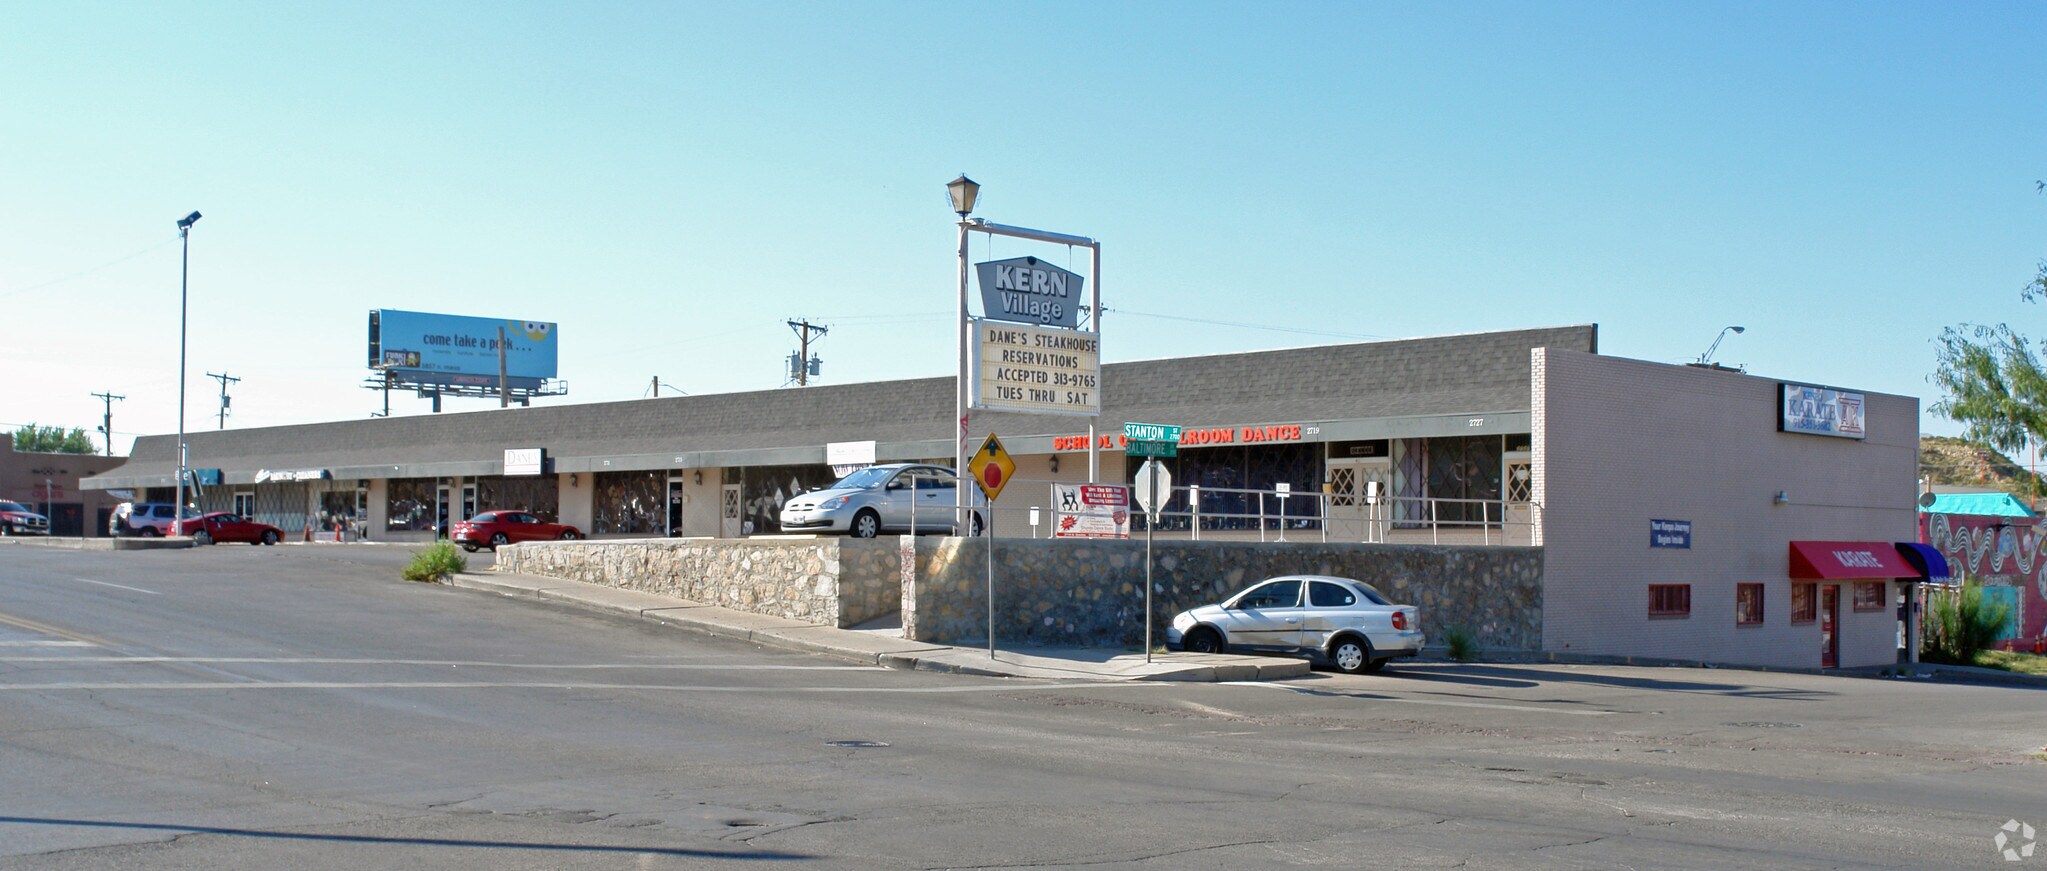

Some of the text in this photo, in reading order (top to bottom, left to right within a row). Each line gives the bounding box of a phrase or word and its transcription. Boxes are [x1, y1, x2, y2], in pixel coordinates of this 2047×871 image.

[996, 264, 1068, 297] KERN
[1000, 291, 1063, 324] Village
[423, 334, 451, 346] come
[454, 333, 477, 348] take
[480, 338, 486, 348] a
[990, 329, 1097, 353] DANE'S STEAKHOUSE
[1003, 349, 1078, 369] RESERVATIONS
[997, 367, 1096, 388] ACCEPTED 313-9765
[997, 386, 1088, 405] TUES THRU SAT
[1788, 399, 1836, 420] KARATE
[1125, 424, 1164, 439] STANTON
[1306, 427, 1319, 435] 2719
[1469, 418, 1483, 427] 2727
[1241, 425, 1301, 443] DANCE
[1126, 442, 1166, 455] BALTIMORE
[1832, 550, 1884, 568] KARATE
